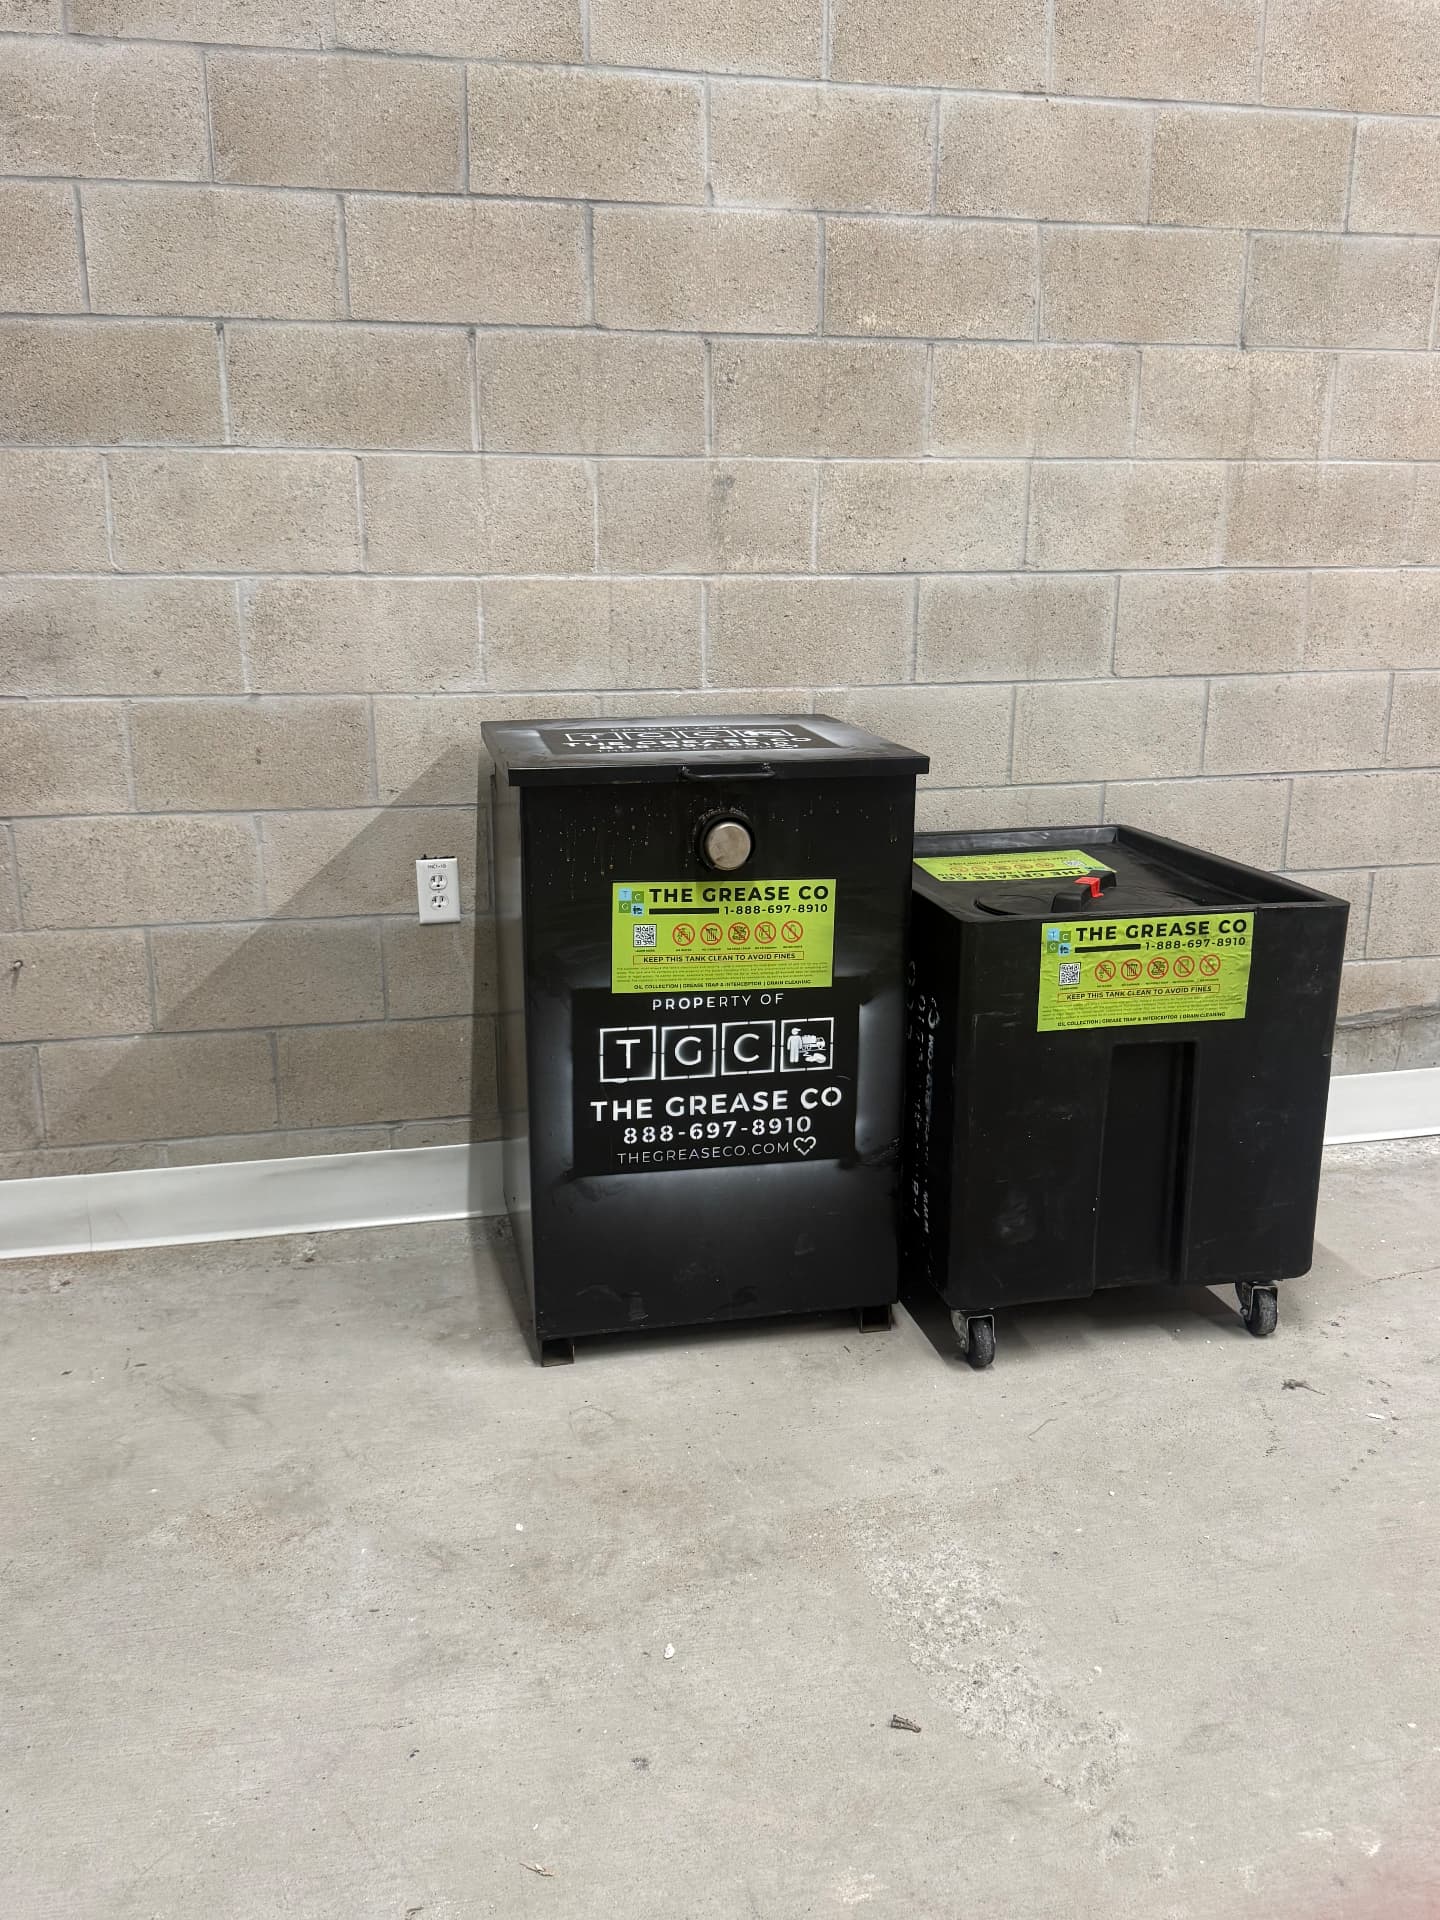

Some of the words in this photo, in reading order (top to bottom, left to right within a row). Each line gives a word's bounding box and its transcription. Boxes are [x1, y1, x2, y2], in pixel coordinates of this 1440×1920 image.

[648, 888, 693, 903] THE
[702, 886, 790, 902] GREASE
[798, 885, 829, 900] CO
[724, 903, 829, 915] 1-888-697-8910
[1076, 925, 1117, 942] THE
[1125, 920, 1210, 939] GREASE
[1218, 918, 1248, 934] CO
[1144, 936, 1246, 951] 1-888-697-8910
[666, 955, 683, 963] THIS
[708, 954, 733, 962] CLEAN
[652, 995, 752, 1011] PROPERTY
[760, 993, 784, 1005] OF
[1127, 989, 1151, 997] CLEAN
[615, 1038, 641, 1069] T
[674, 1036, 702, 1066] G
[733, 1033, 760, 1062] C
[590, 1099, 653, 1122] THE
[665, 1090, 789, 1117] GREASE
[800, 1086, 842, 1110] CO
[623, 1116, 812, 1144] 888-697-8910
[616, 1141, 790, 1165] THEGREASECO.COM
